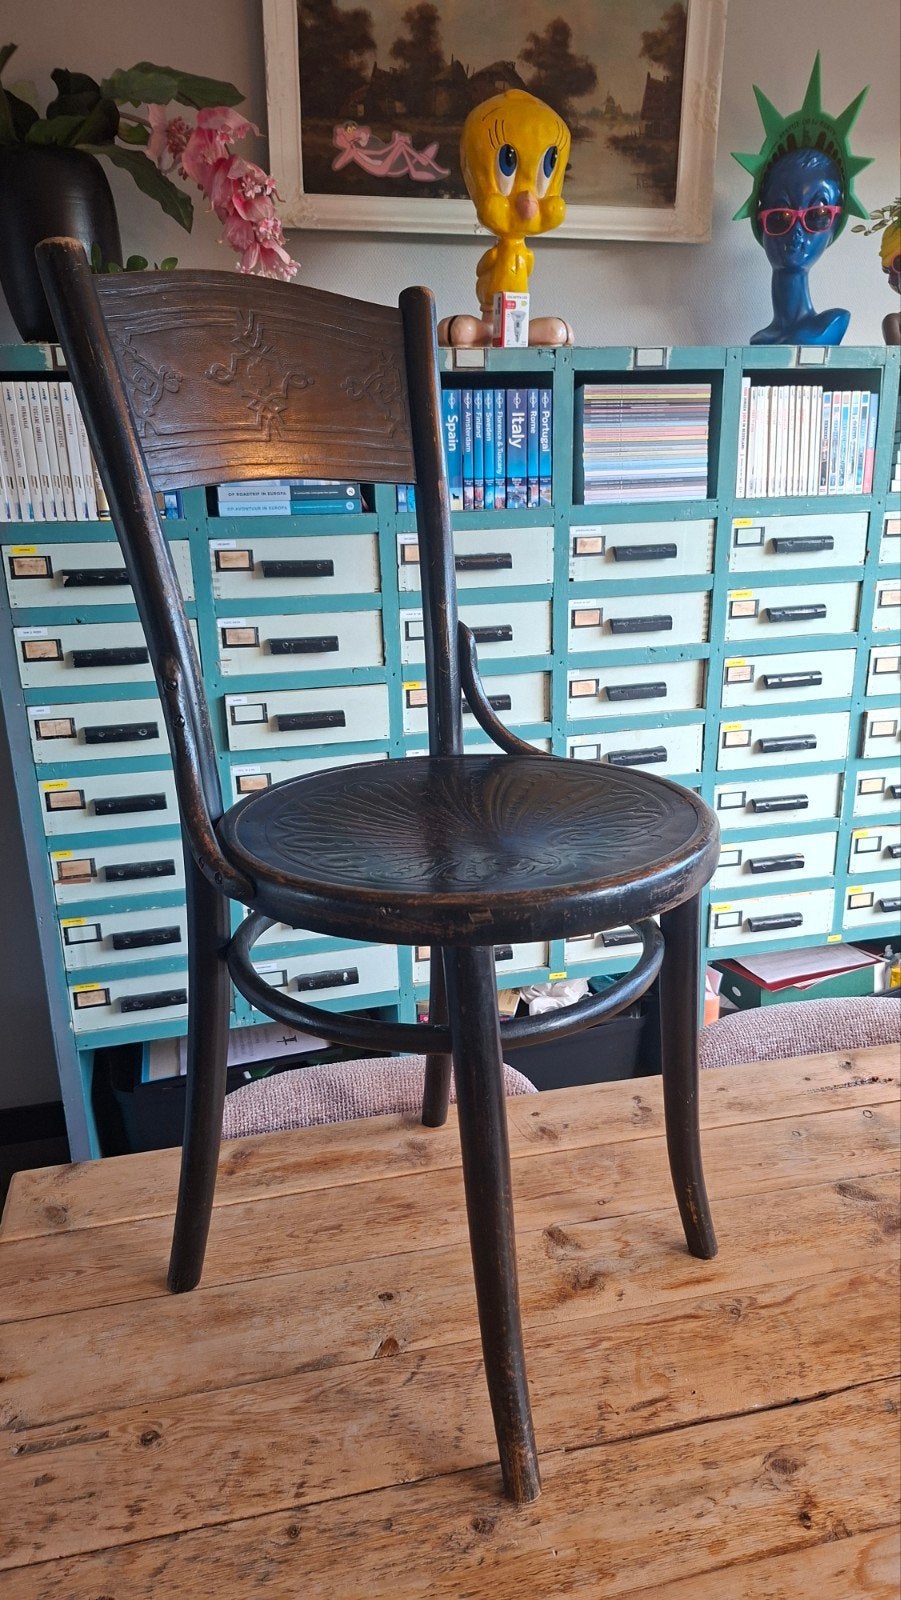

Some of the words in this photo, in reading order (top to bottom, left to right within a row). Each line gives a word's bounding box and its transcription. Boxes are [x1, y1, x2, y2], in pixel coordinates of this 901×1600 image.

[446, 415, 458, 451] Spain
[509, 412, 525, 448] Italy
[540, 410, 550, 452] Portugal
[496, 448, 504, 475] Tuscany
